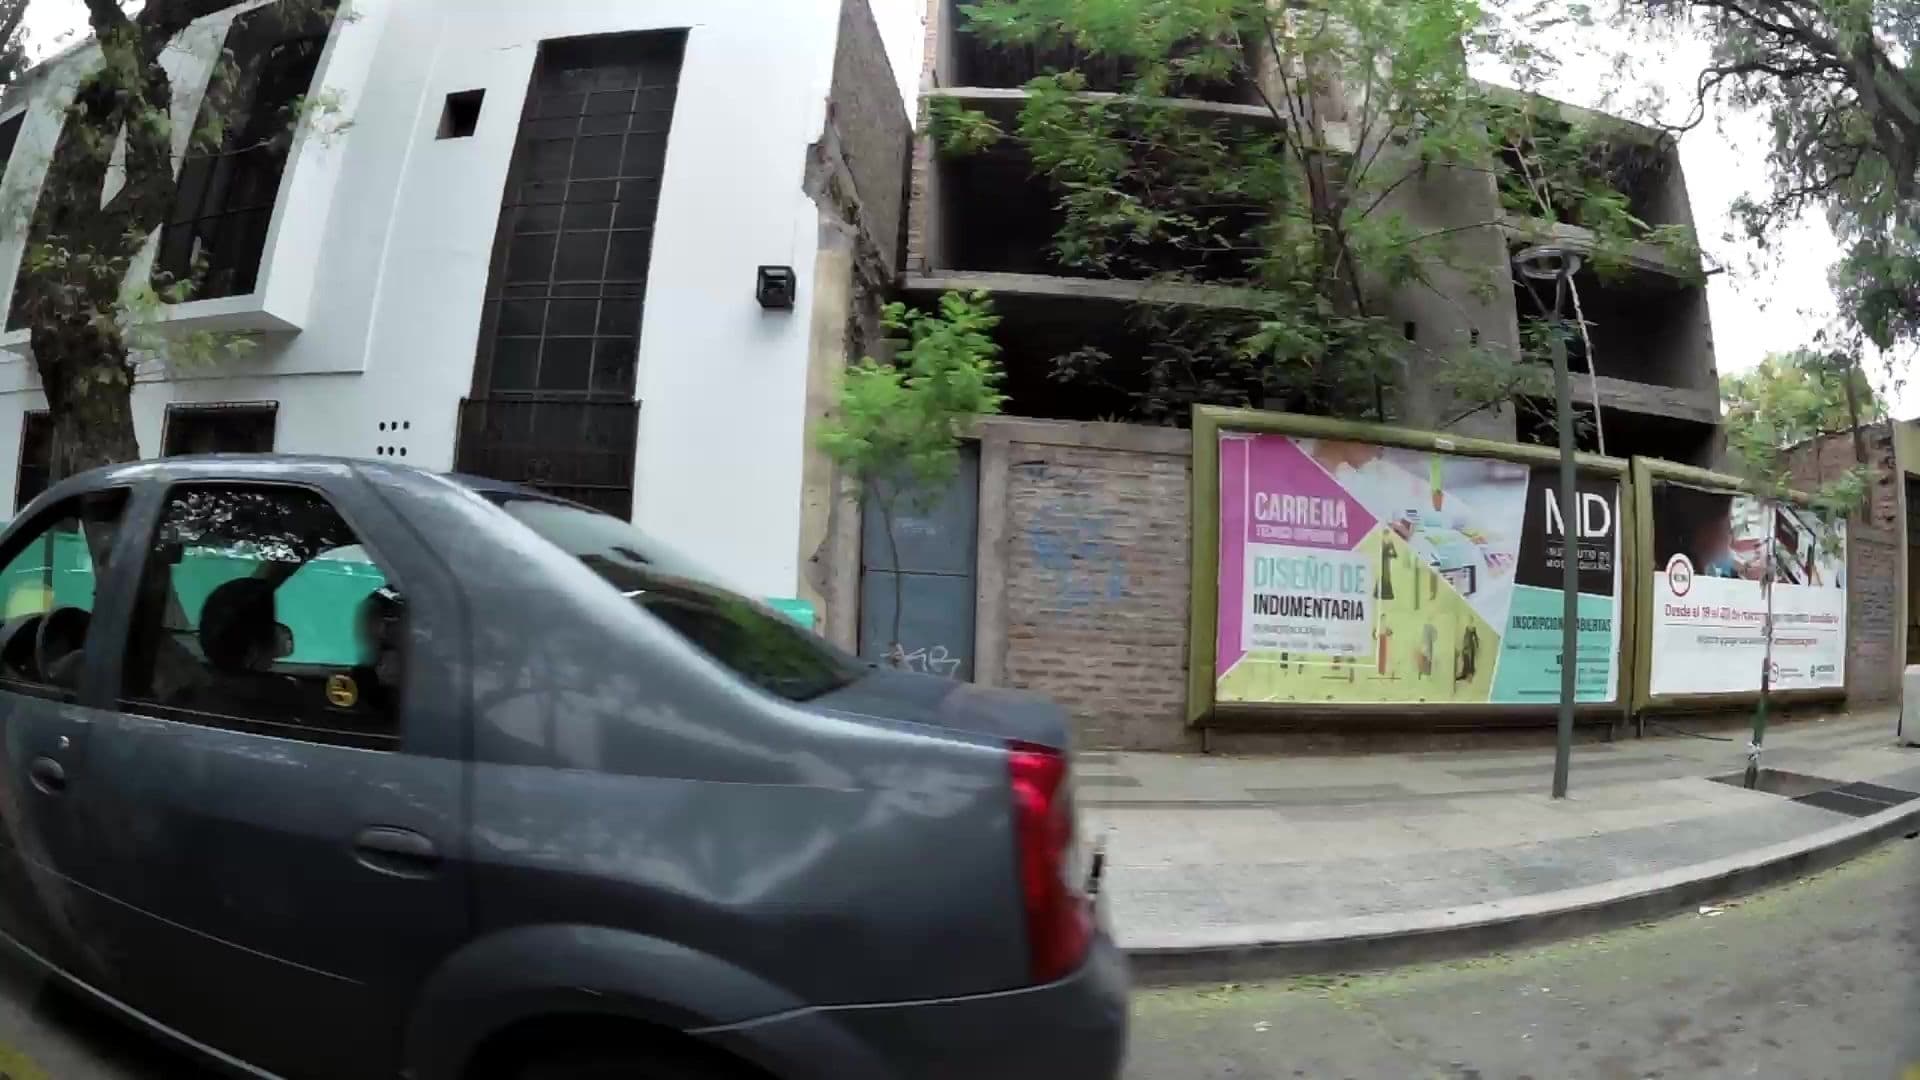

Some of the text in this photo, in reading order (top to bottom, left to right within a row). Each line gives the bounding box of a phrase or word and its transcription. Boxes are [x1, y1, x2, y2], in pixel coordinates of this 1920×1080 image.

[1255, 491, 1348, 529] CARRERA
[1254, 555, 1366, 594] DISEÑO DE
[1253, 593, 1365, 621] INDUMENTARIA
